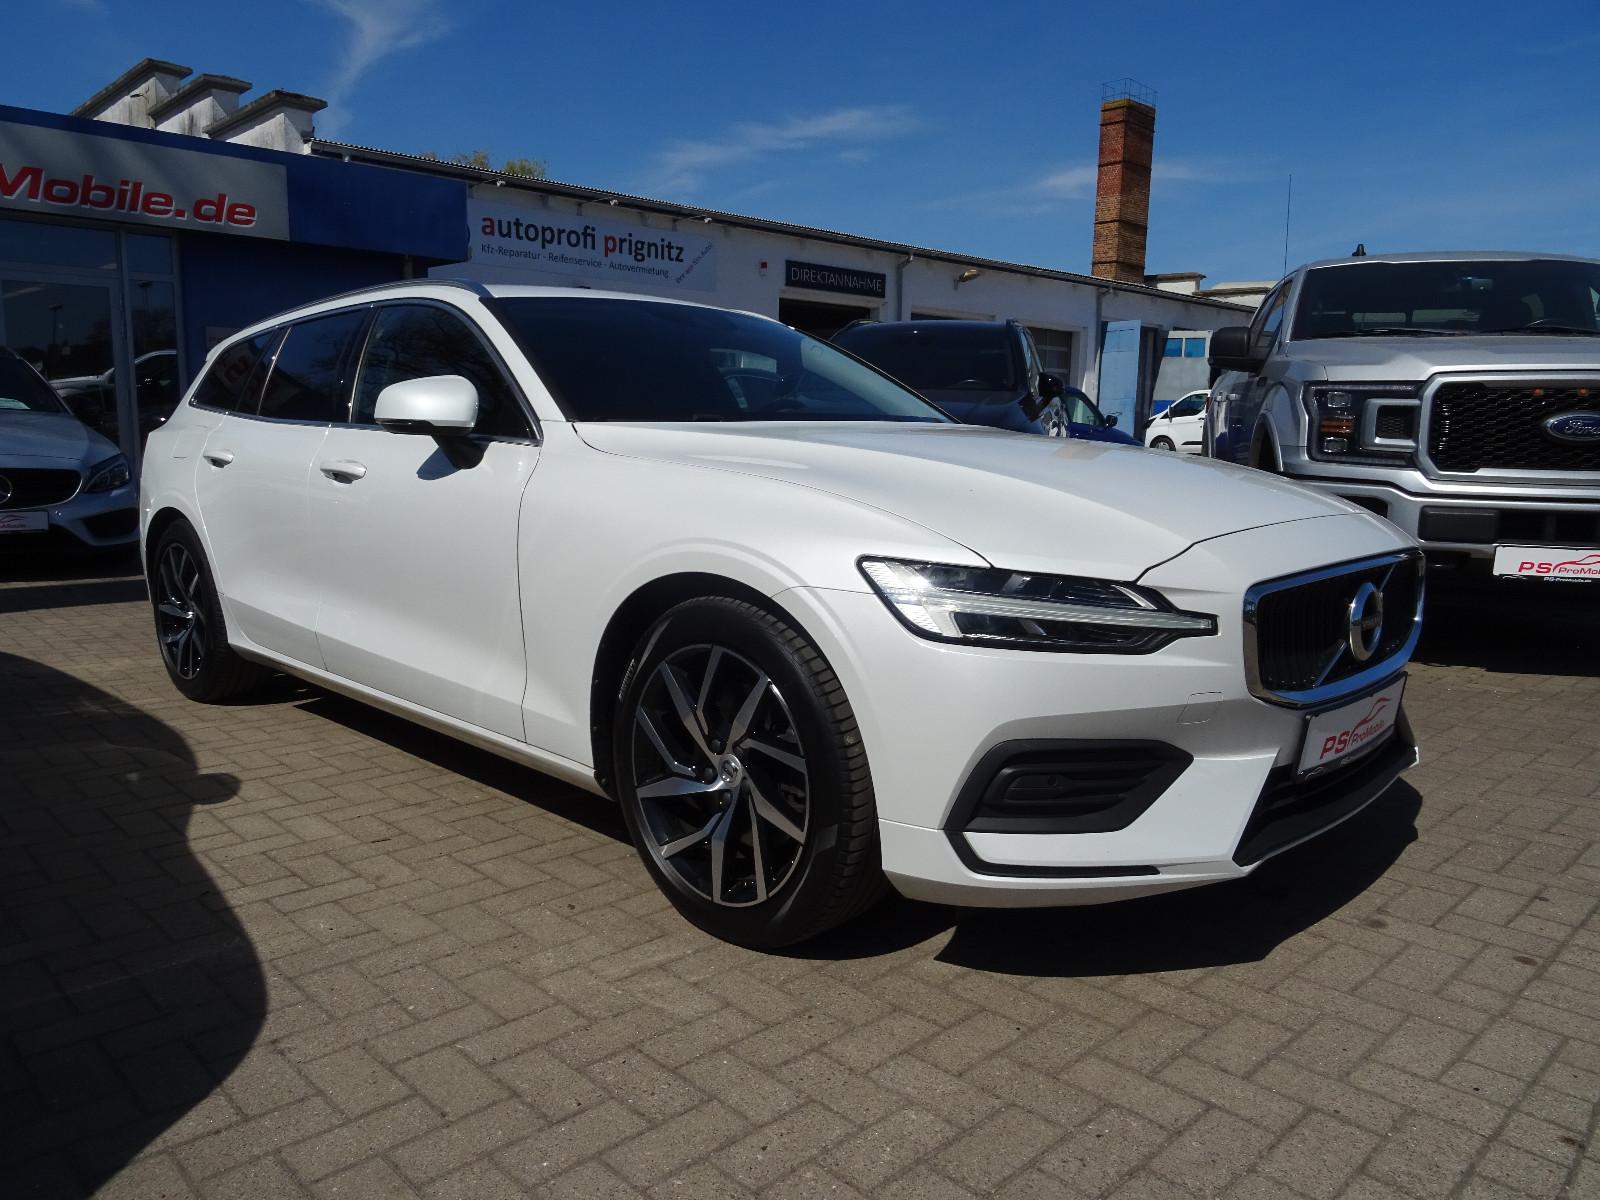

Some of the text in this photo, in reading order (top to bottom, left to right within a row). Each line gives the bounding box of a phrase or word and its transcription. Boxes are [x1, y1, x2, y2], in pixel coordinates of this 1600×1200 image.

[481, 217, 596, 250] autoprofi
[604, 232, 684, 263] prignitz
[481, 243, 541, 260] Kfz-Reparatur
[548, 252, 603, 269] Reifenservice
[608, 261, 670, 279] Autovermietung
[791, 267, 883, 292] DIREKTANNAHME
[1518, 561, 1553, 574] PS
[1319, 730, 1351, 760] PS
